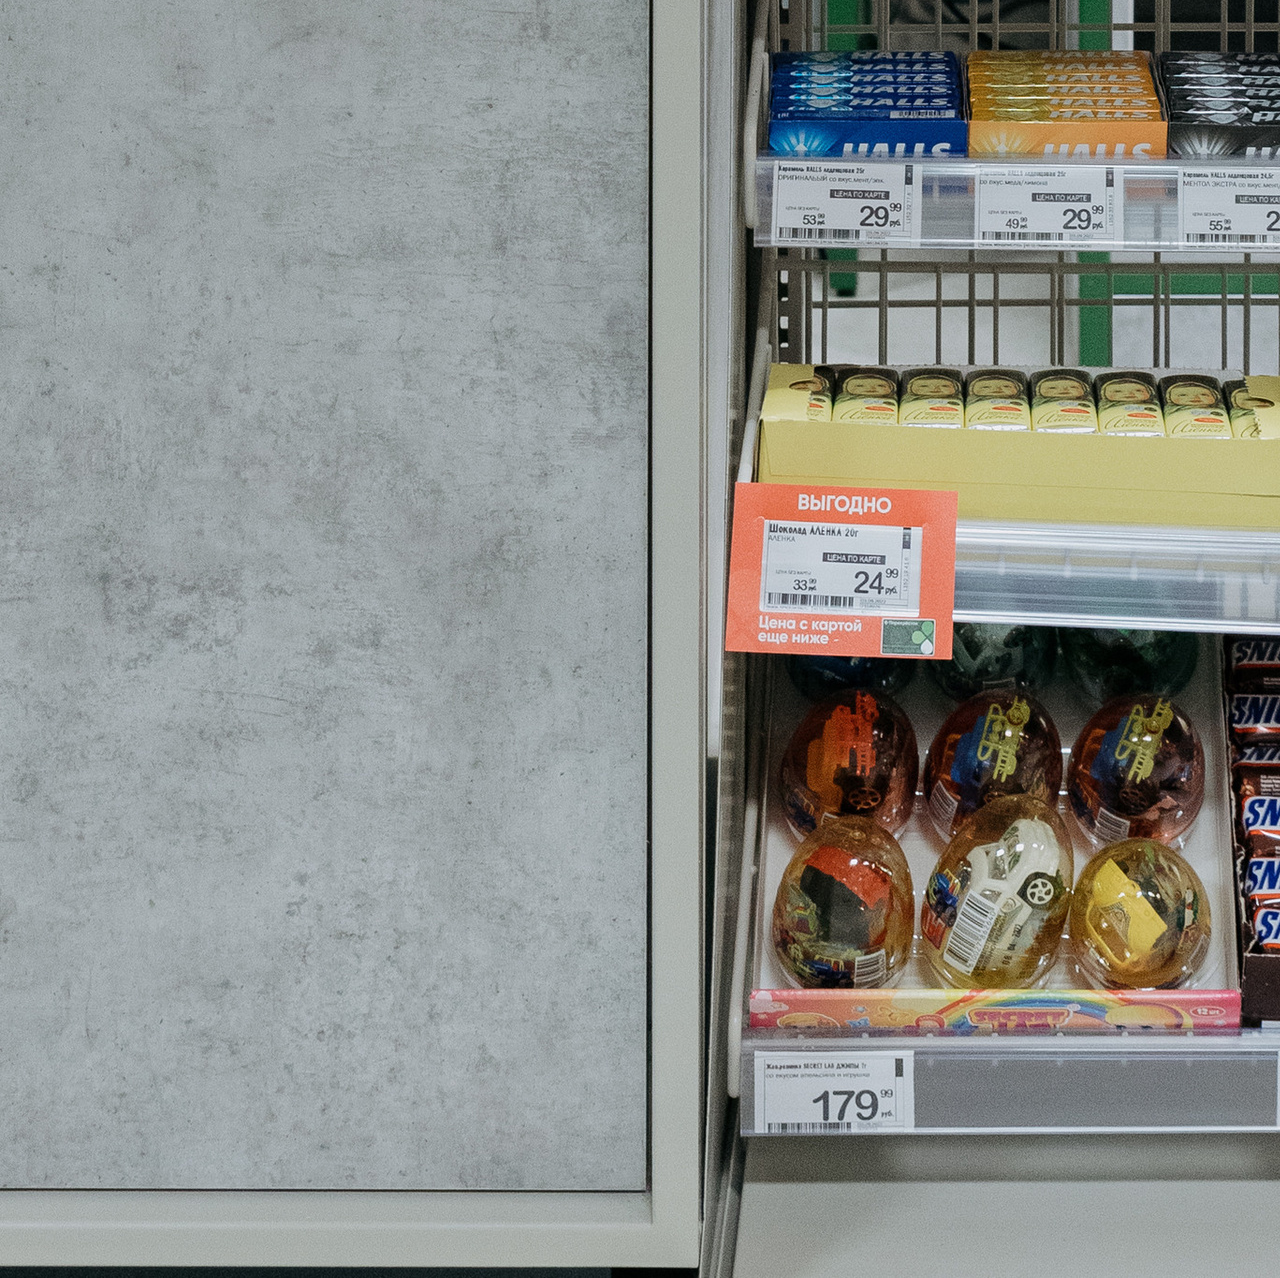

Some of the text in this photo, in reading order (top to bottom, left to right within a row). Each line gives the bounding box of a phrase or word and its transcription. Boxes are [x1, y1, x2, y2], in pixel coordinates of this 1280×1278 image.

[859, 204, 890, 228] 29
[1062, 207, 1091, 230] 29
[797, 494, 892, 515] ВЫГОДНО
[769, 524, 807, 536] Шоколад
[854, 571, 884, 595] 24
[812, 1089, 879, 1122] 179
